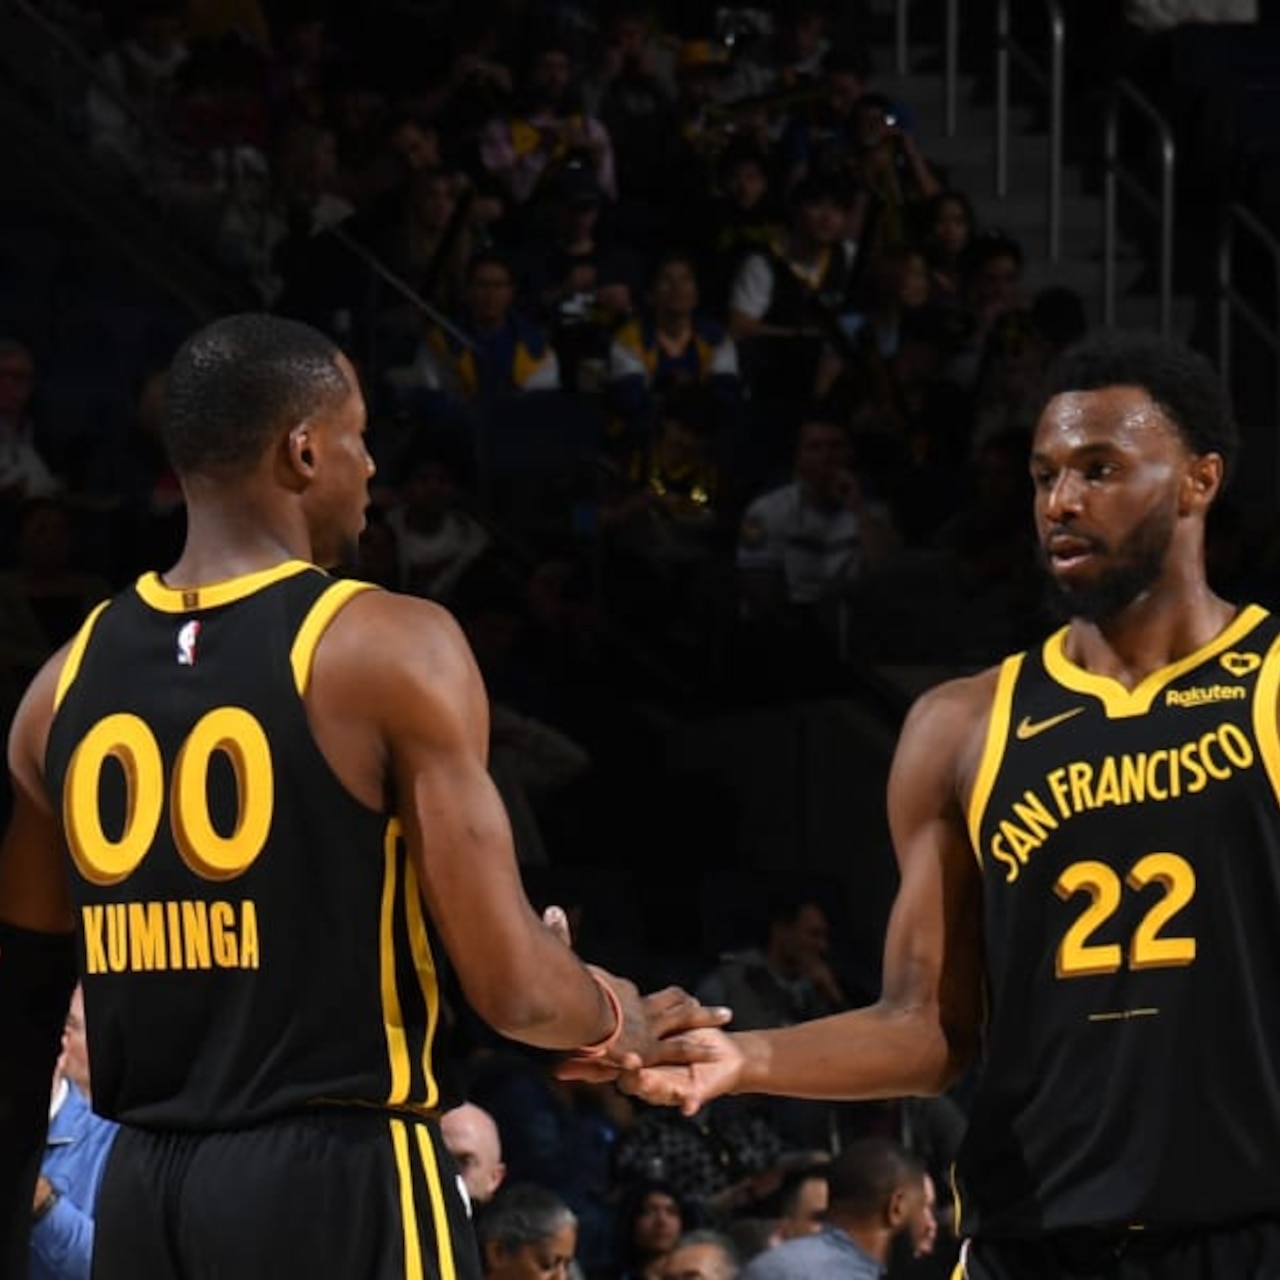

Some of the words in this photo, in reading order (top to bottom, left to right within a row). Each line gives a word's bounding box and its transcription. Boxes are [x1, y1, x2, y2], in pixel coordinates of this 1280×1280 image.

[1165, 684, 1247, 708] Rakuten
[62, 704, 276, 888] 00
[990, 790, 1060, 884] SAN
[1045, 721, 1255, 820] FRANCISCO
[81, 898, 261, 975] KUMINGA
[1052, 851, 1198, 980] 22
